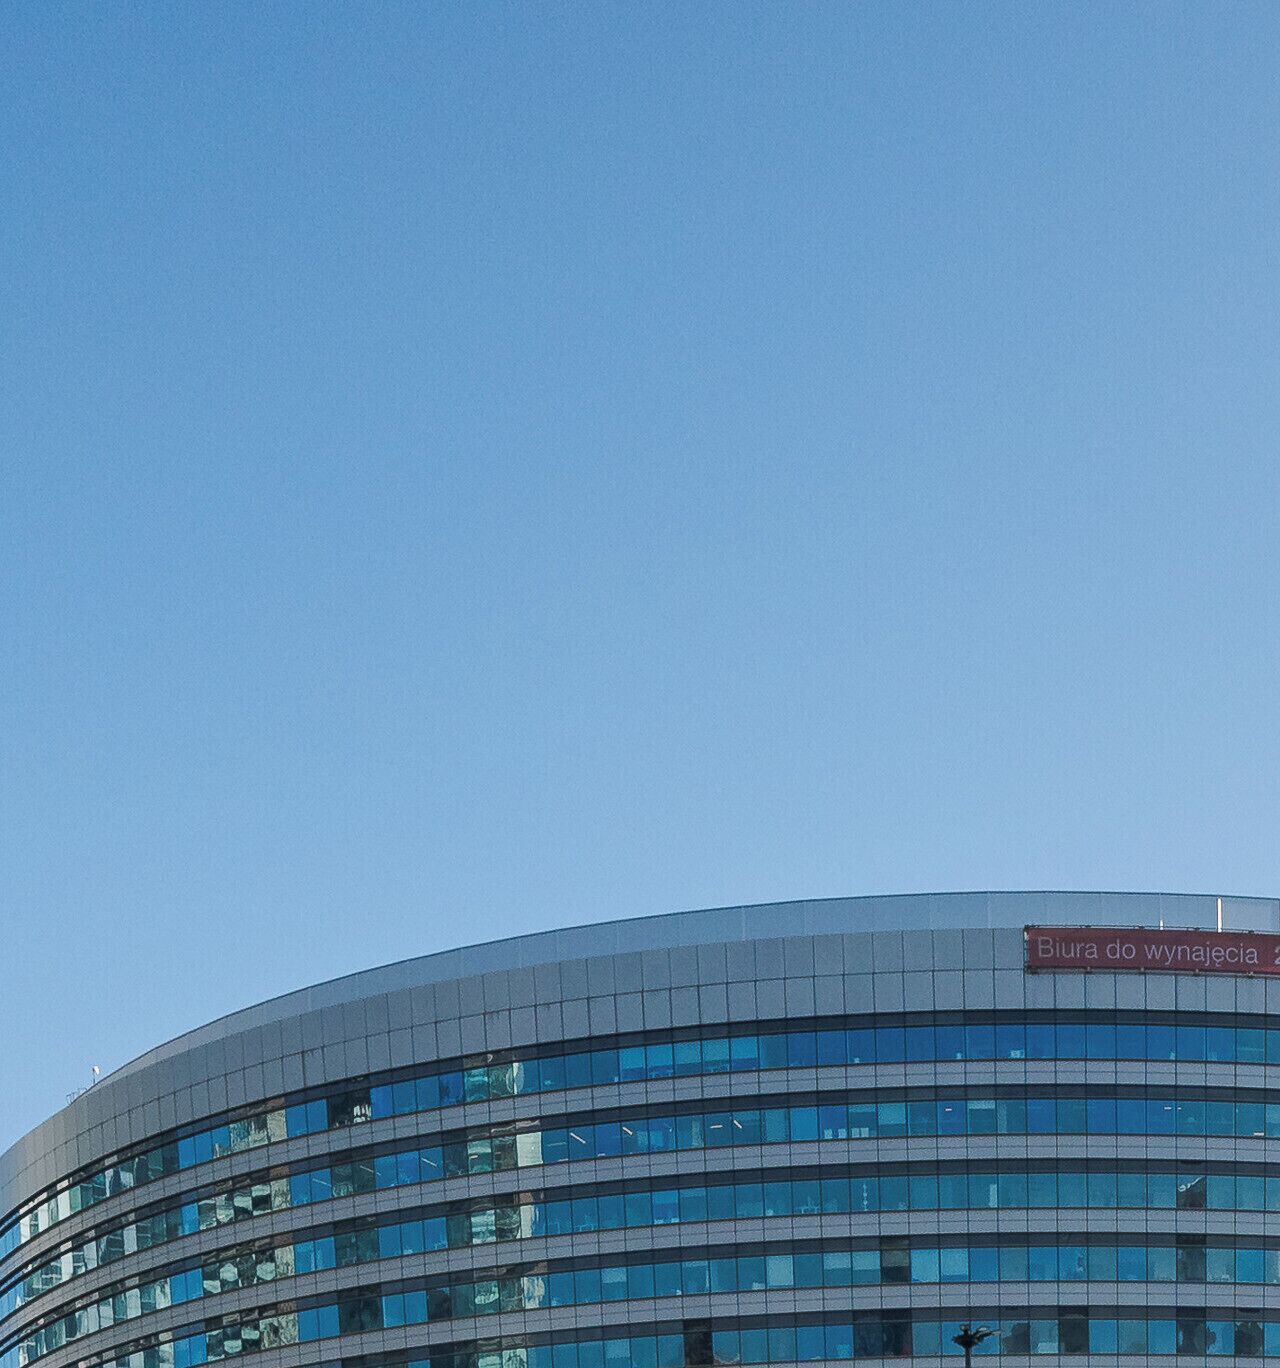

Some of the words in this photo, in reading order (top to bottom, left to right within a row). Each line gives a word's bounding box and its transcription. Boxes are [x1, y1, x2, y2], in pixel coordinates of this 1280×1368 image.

[1037, 936, 1099, 960] Biura
[1105, 938, 1137, 960] do
[1143, 940, 1259, 968] wynajęcia
